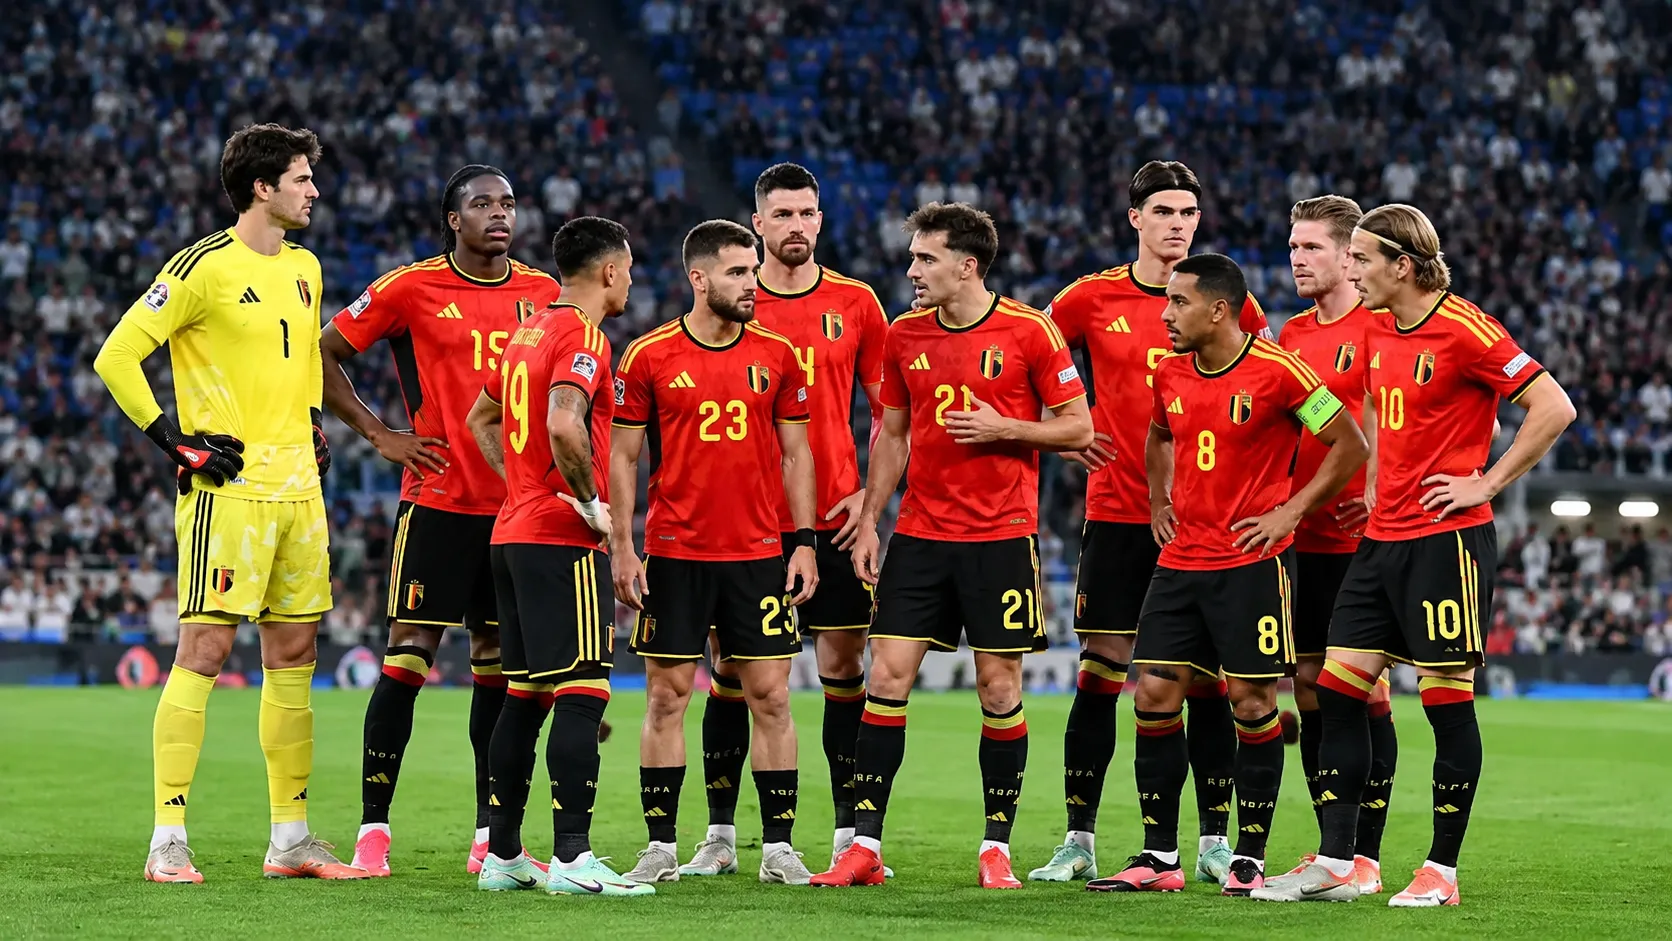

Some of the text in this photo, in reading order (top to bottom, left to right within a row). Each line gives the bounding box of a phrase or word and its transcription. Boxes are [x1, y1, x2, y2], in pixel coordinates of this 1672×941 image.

[279, 318, 290, 359] 1
[471, 329, 509, 371] 15
[794, 346, 815, 387] 4
[501, 359, 529, 455] 19
[698, 399, 748, 442] 23
[934, 384, 972, 427] 21
[1379, 385, 1405, 431] 10
[1196, 430, 1216, 471] 8
[760, 594, 795, 636] 23
[1001, 588, 1034, 630] 21
[1422, 599, 1461, 641] 10
[1257, 615, 1279, 655] 8
